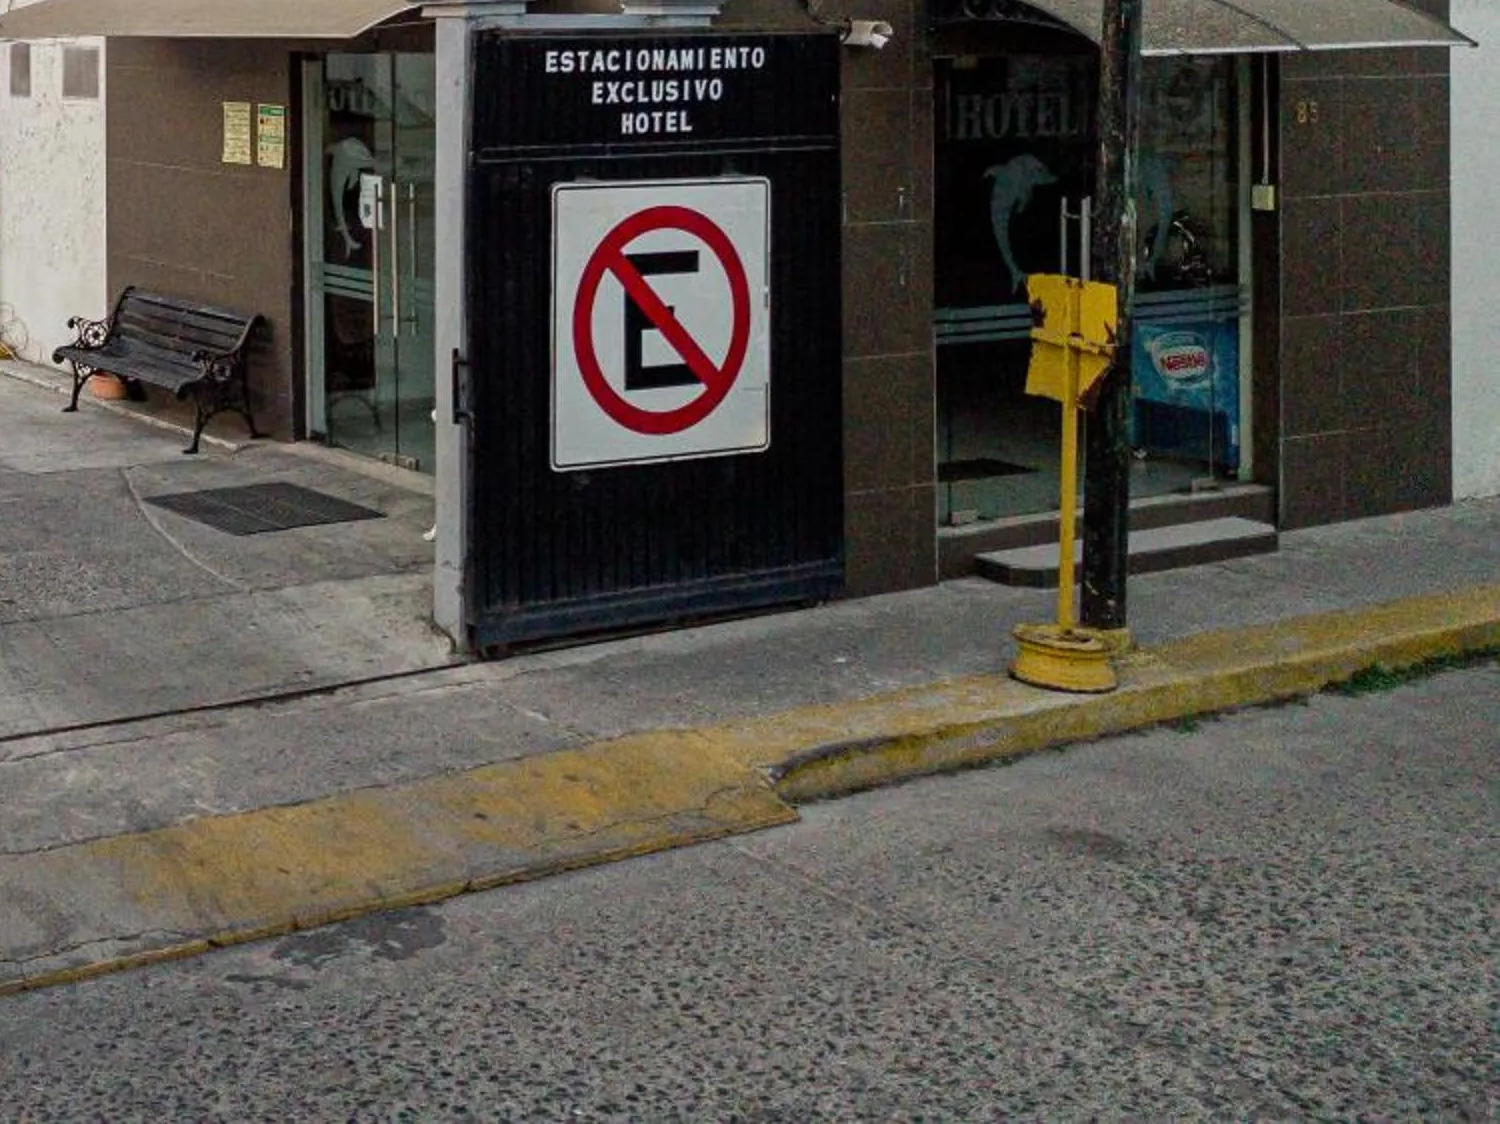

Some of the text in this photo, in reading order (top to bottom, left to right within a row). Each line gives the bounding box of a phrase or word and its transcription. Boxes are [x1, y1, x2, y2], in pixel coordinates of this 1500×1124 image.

[545, 45, 766, 74] ESTACIONAMIENTO
[591, 78, 725, 105] EXCLUSIVO
[620, 109, 693, 136] HOTEL
